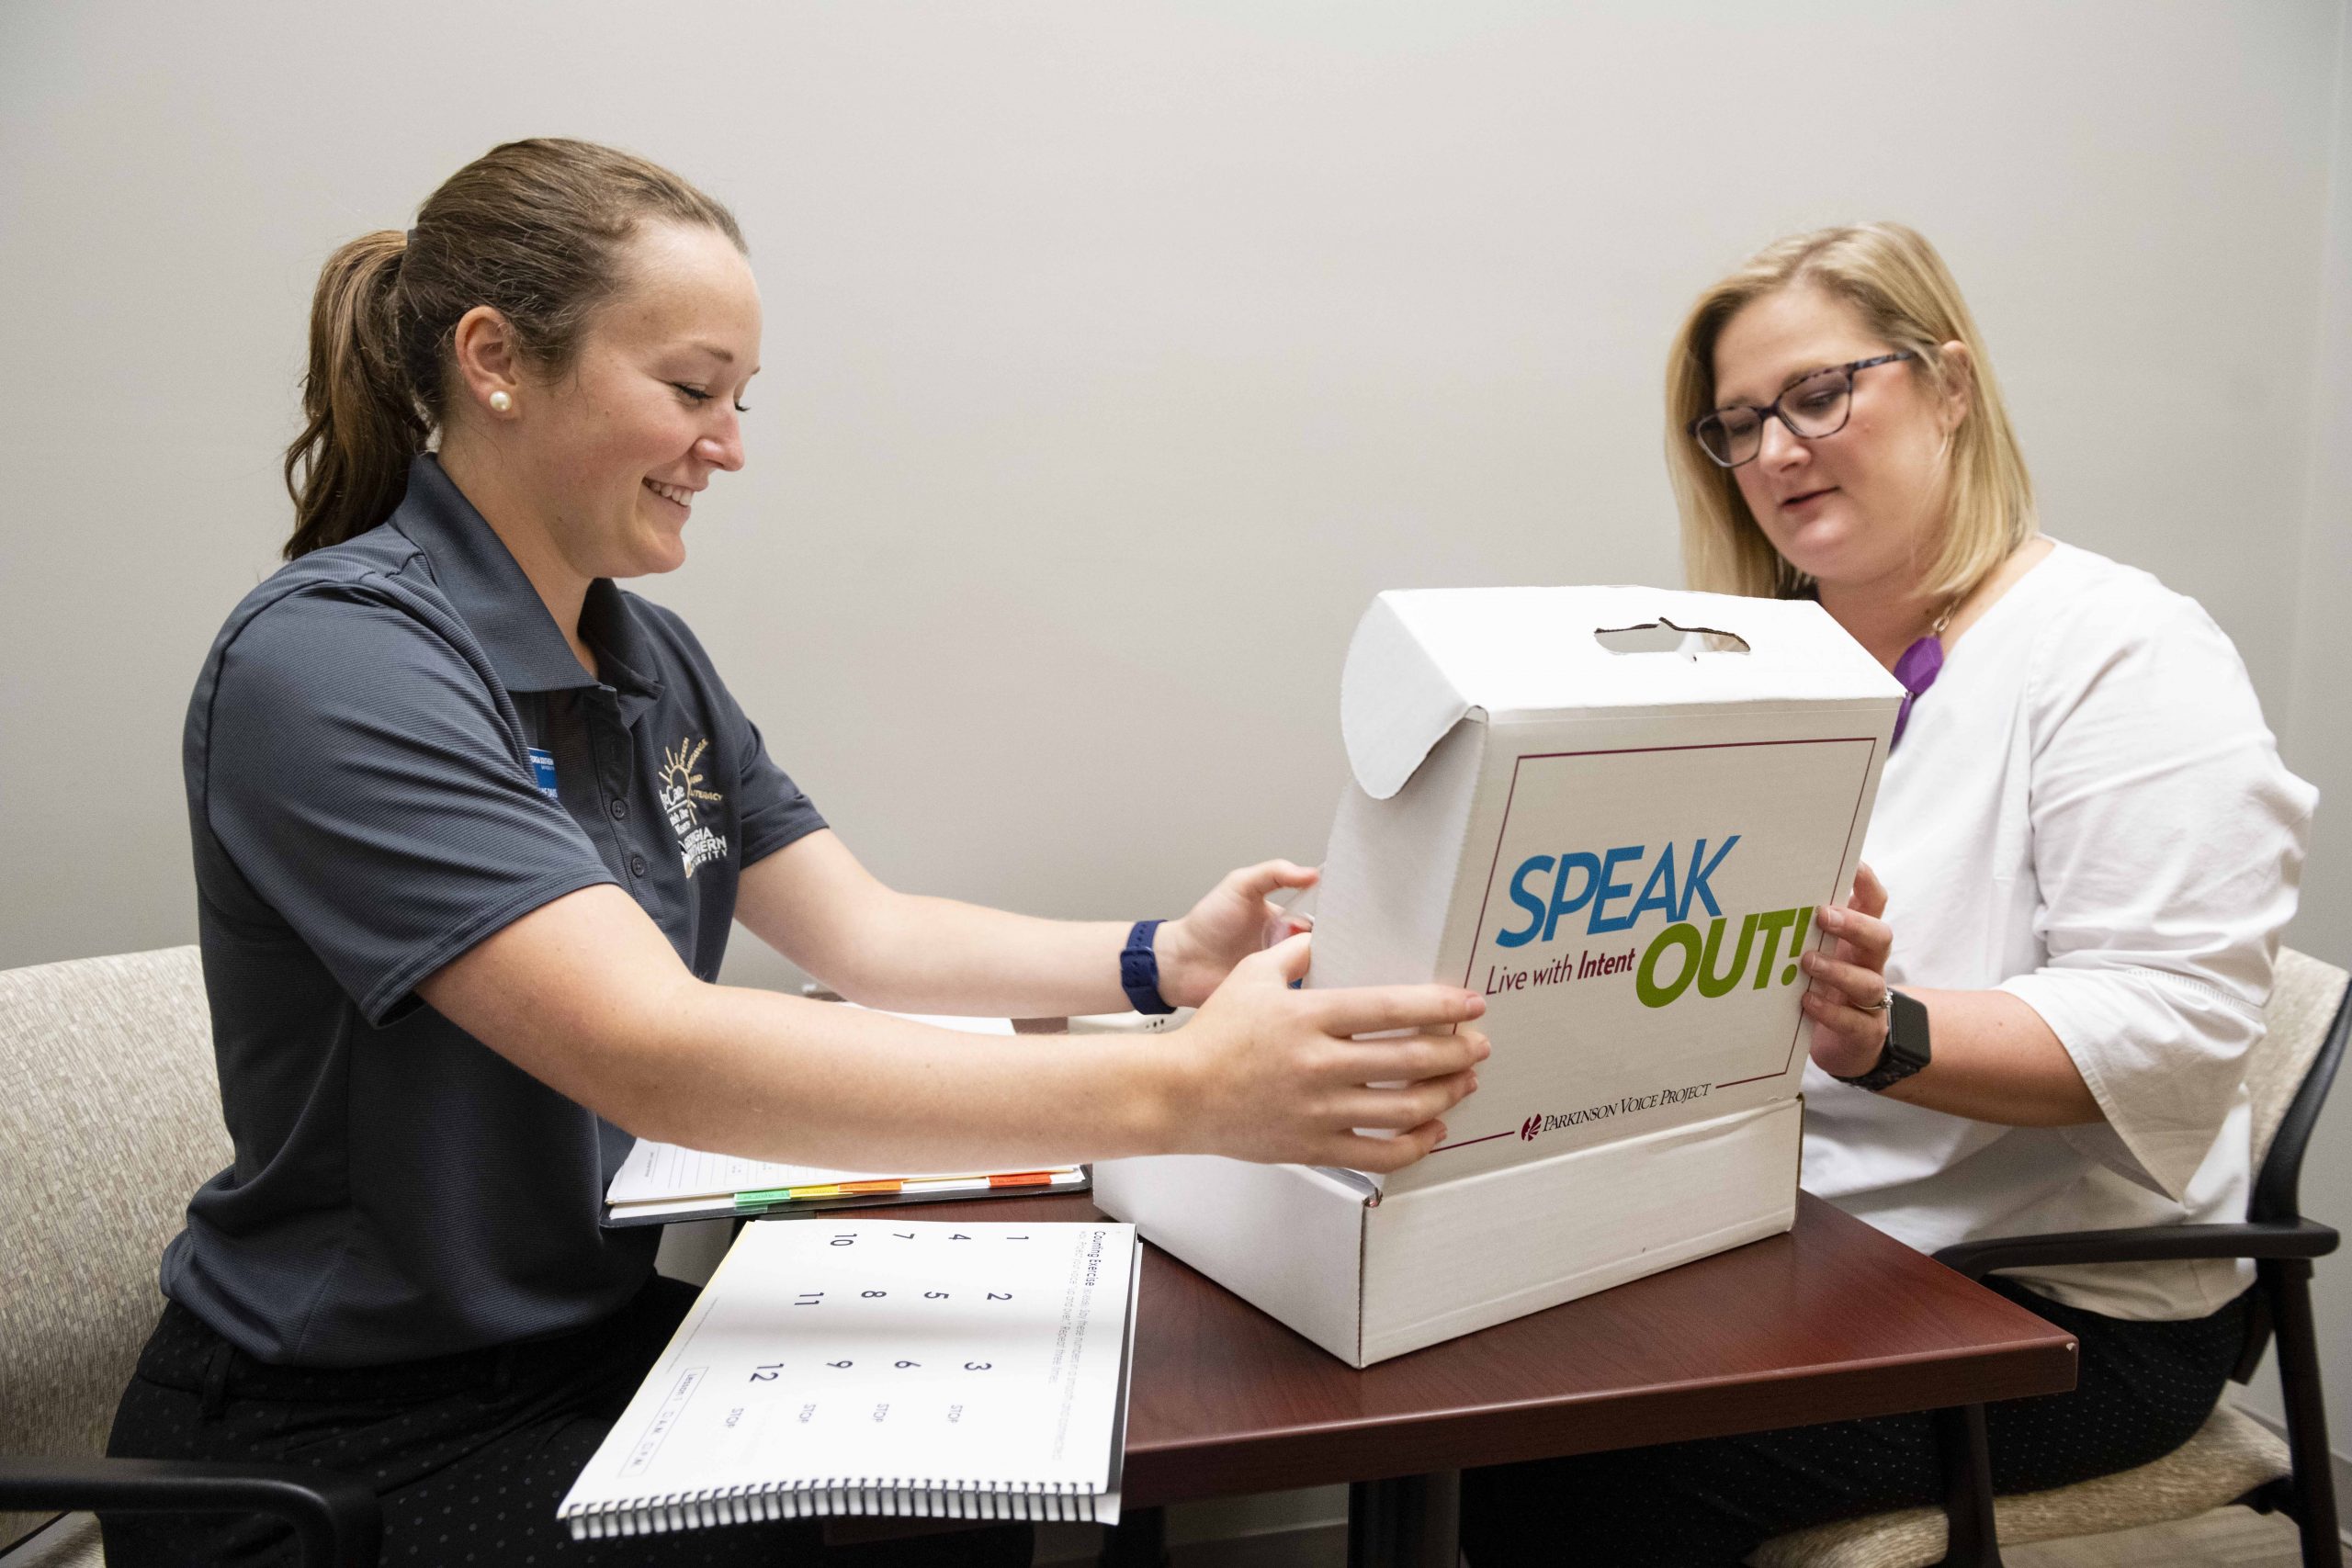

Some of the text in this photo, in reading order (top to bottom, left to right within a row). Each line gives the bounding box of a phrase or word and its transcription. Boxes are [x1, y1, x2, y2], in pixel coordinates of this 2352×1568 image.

[1495, 834, 1742, 948] SPEAK
[1635, 906, 1814, 1009] OUT!
[1485, 948, 1635, 996] Live with Intent
[1542, 1083, 1712, 1133] PARKINSON VOICE PROJECT
[1087, 1230, 1107, 1258] Counting
[1084, 1259, 1102, 1287] Exercise
[861, 1290, 887, 1299] 8
[987, 1292, 1012, 1301] 2
[727, 1233, 857, 1428] 10 11 12 STOP
[874, 1233, 971, 1424] 4 5 6 STOP
[826, 1359, 853, 1369] 9
[964, 1361, 992, 1371] 3
[676, 1373, 698, 1396] Lesson
[799, 1404, 816, 1424] STOP
[947, 1405, 963, 1424] STOP
